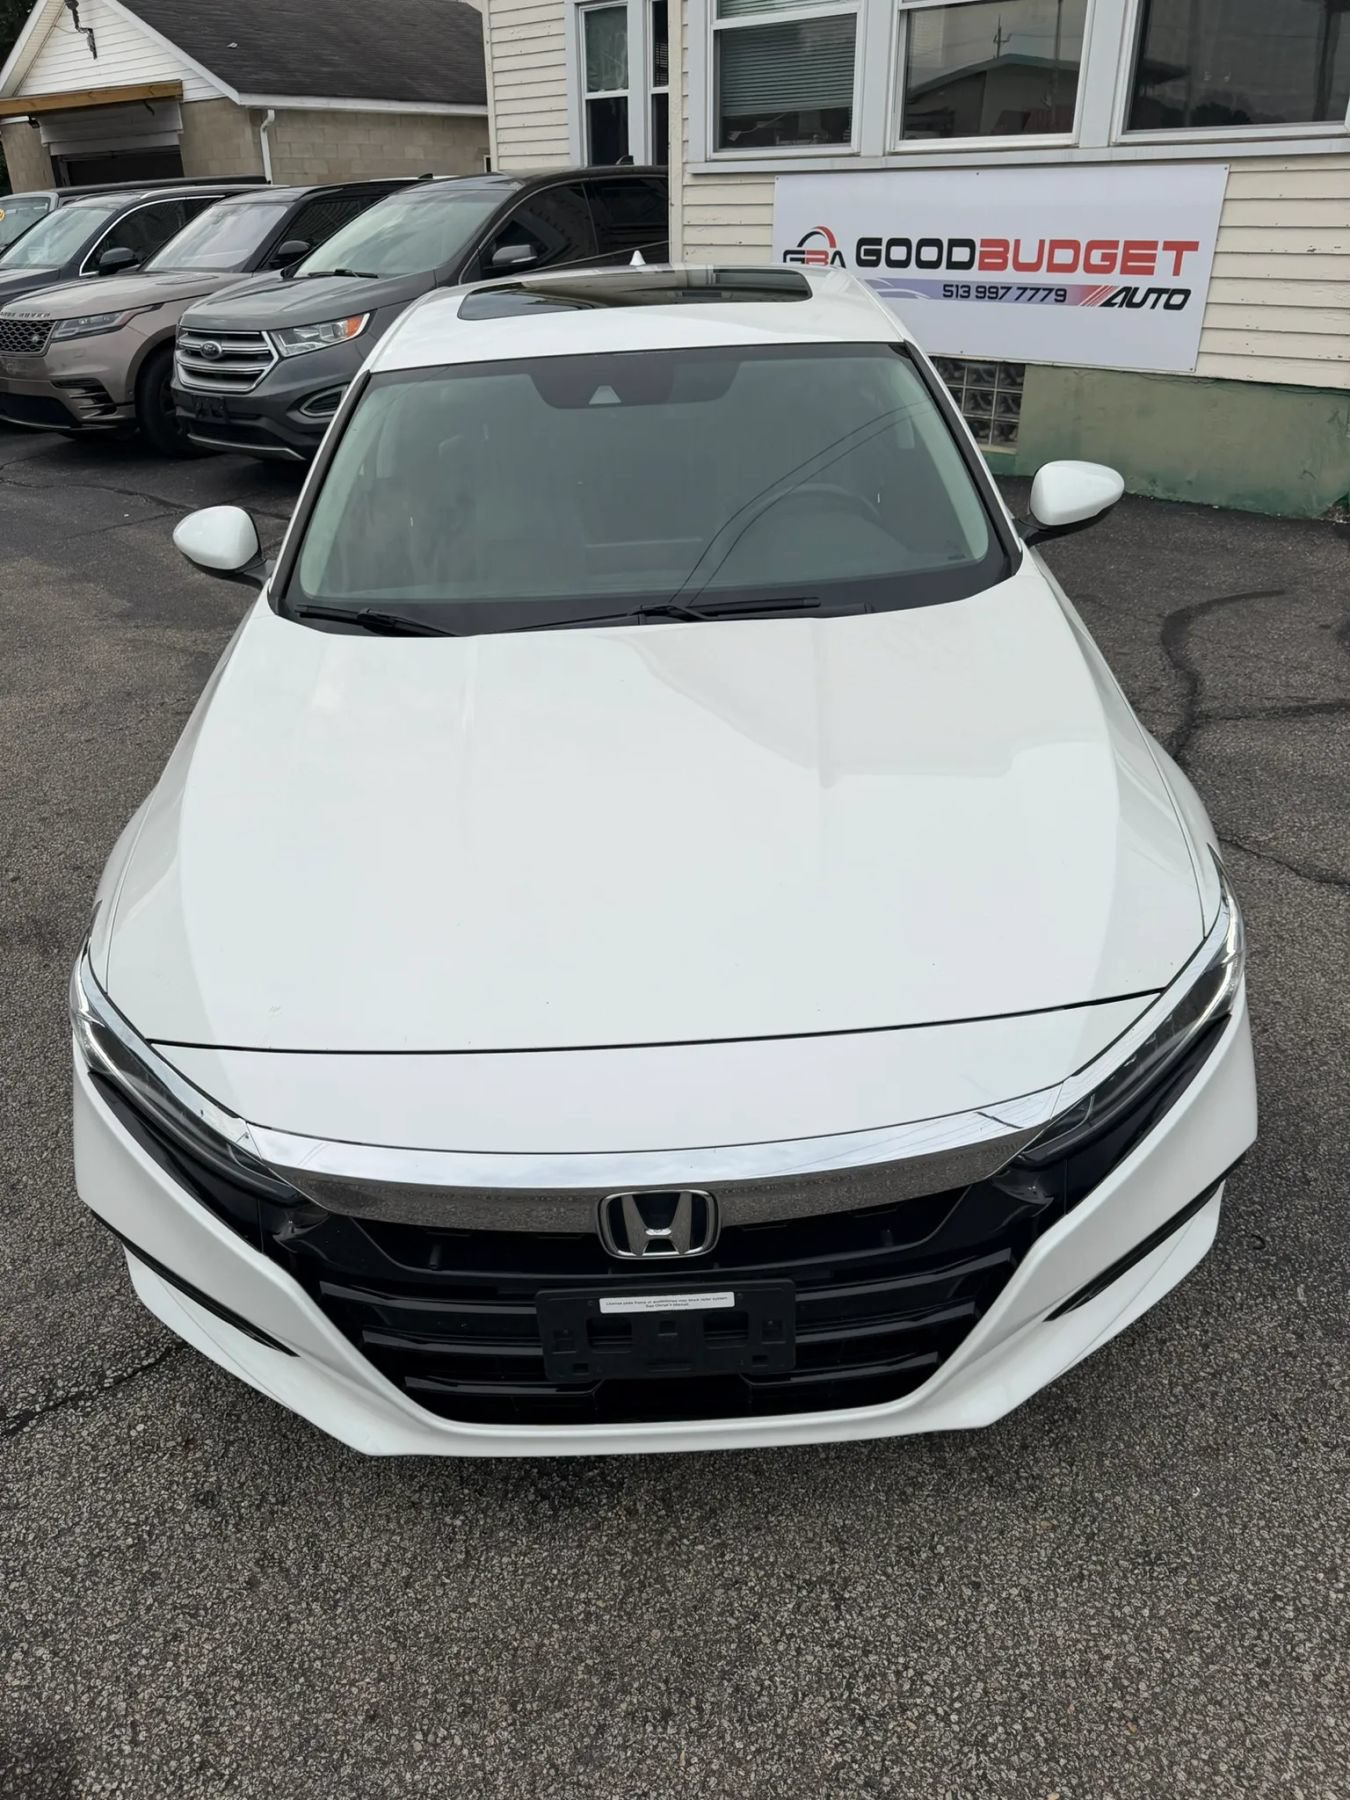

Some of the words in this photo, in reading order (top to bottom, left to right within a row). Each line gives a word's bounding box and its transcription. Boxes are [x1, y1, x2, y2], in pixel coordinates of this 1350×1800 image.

[855, 237, 1199, 276] GOODBUDGET
[942, 284, 970, 299] 513
[975, 285, 1013, 300] 997
[1014, 286, 1068, 303] 7779
[1099, 286, 1192, 311] AUTO
